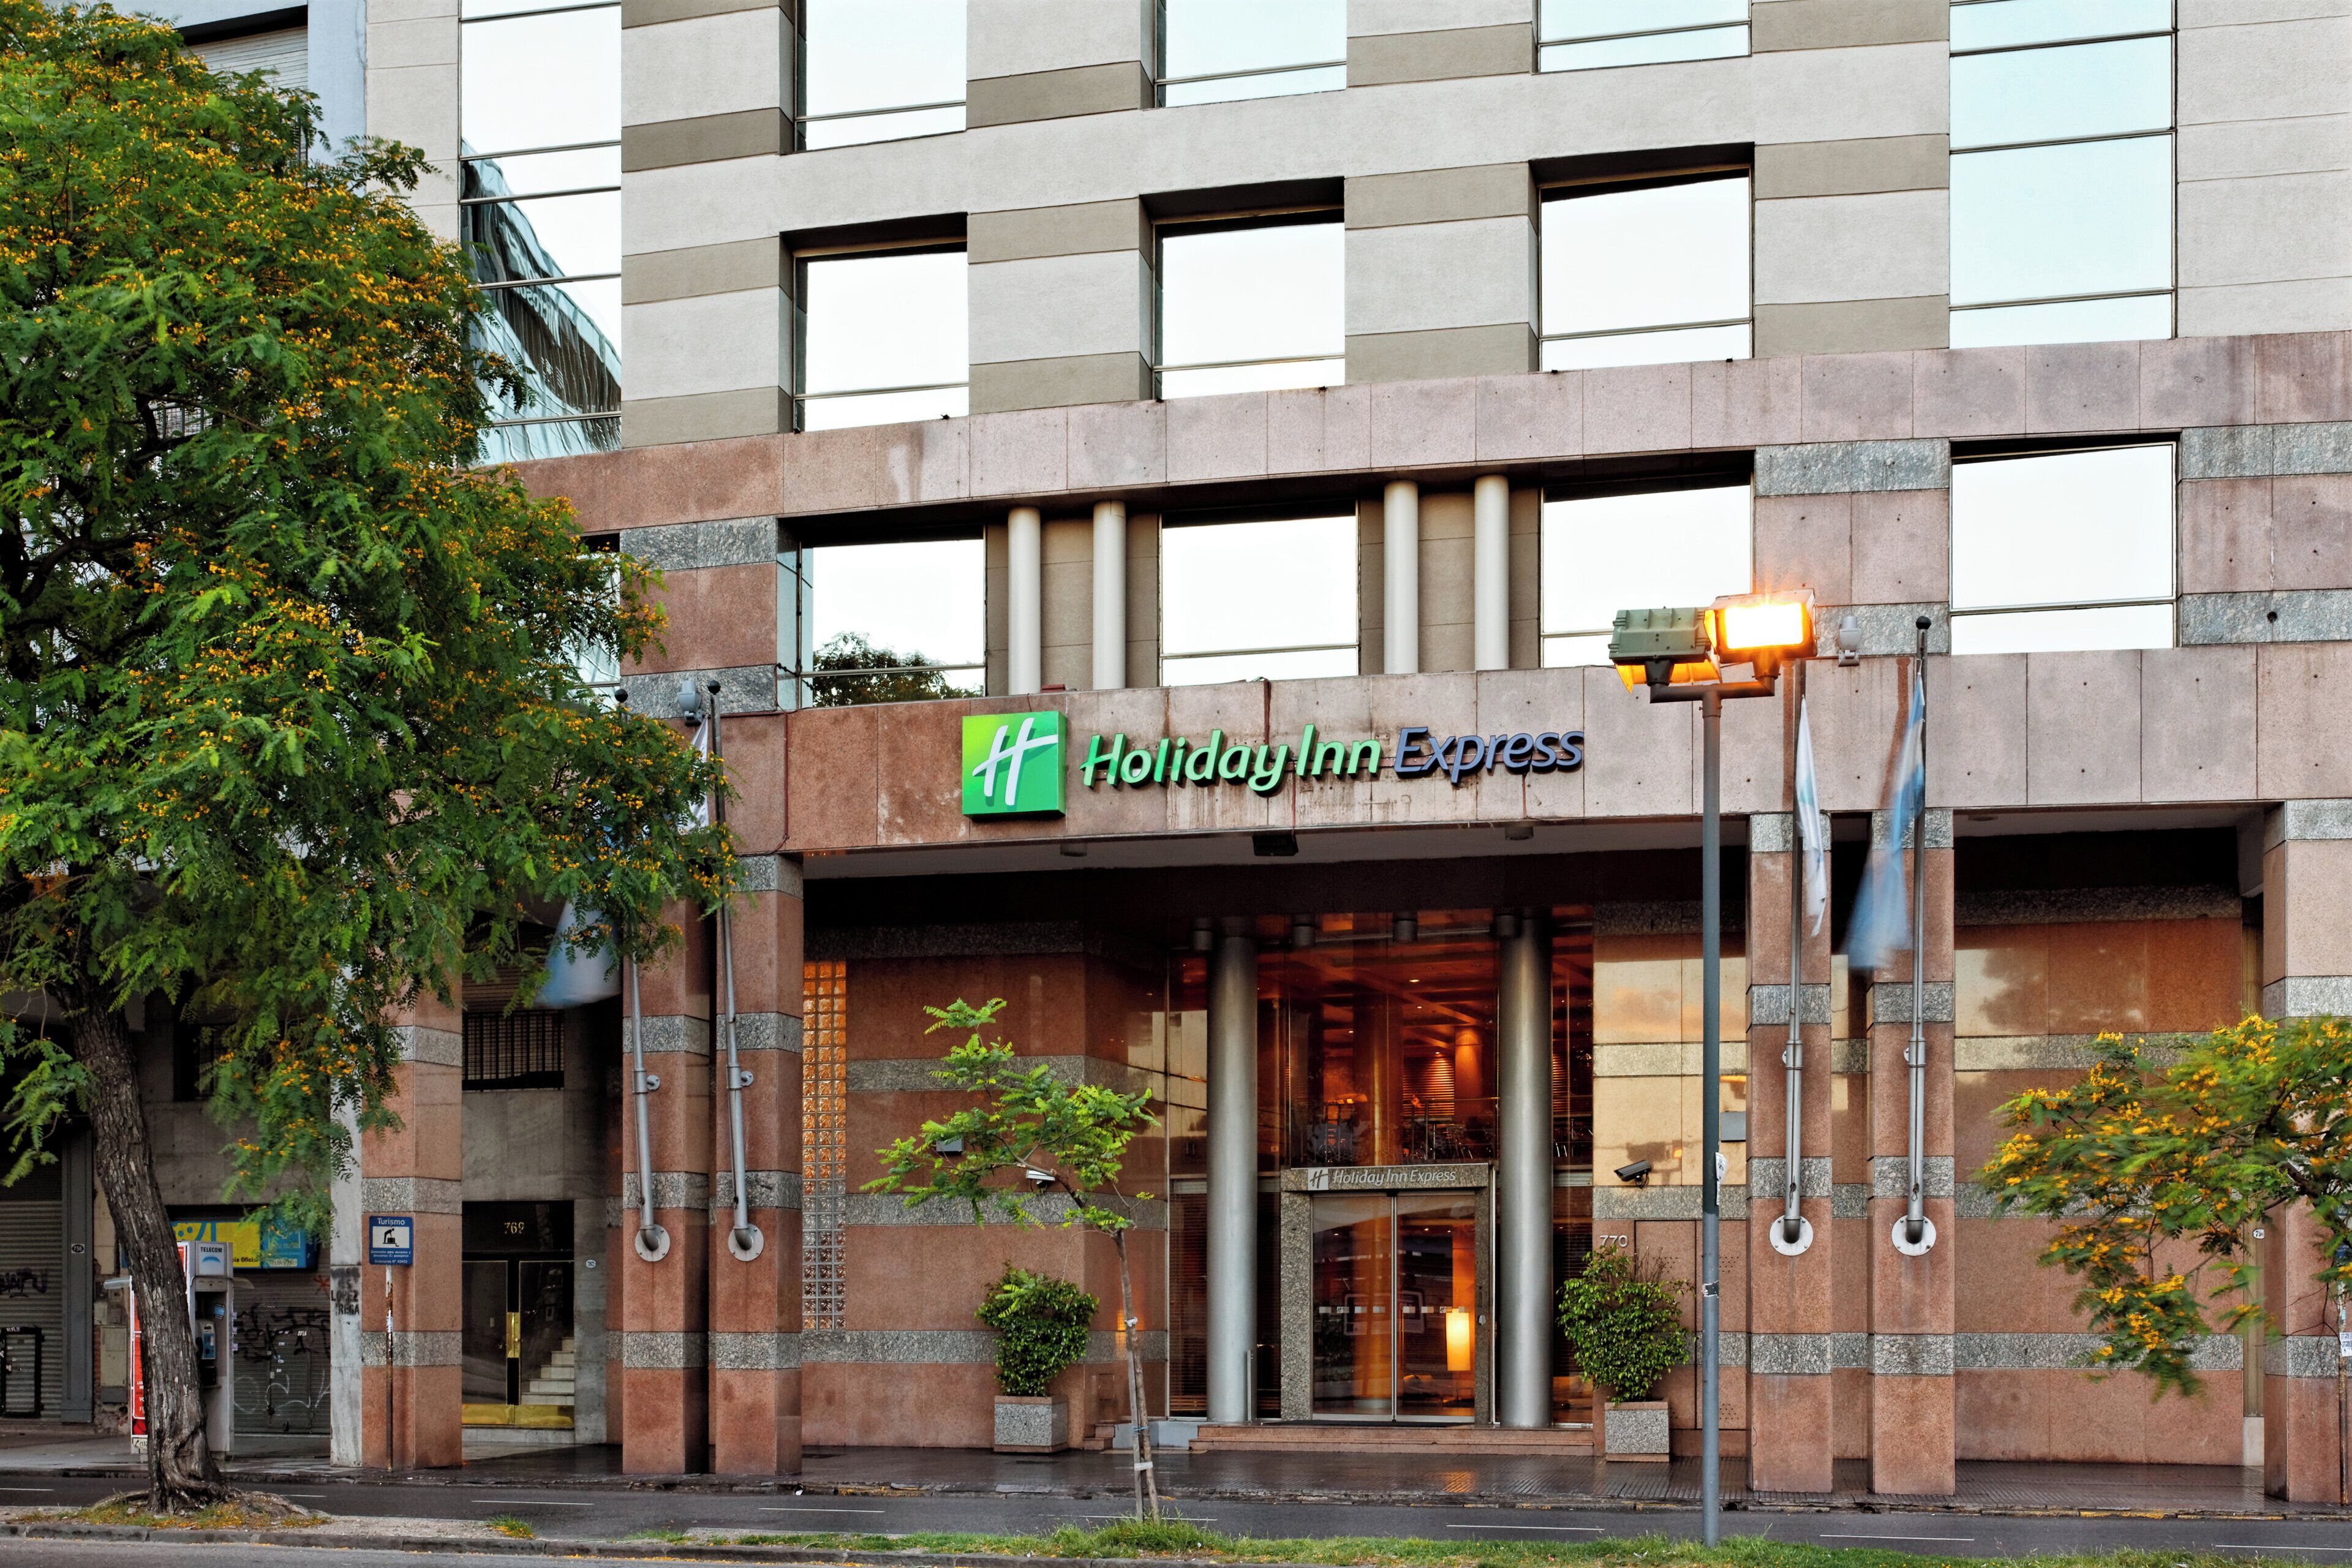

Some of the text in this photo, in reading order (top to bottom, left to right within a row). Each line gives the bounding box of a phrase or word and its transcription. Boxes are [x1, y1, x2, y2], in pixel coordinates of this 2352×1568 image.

[1394, 726, 1585, 785] Express
[1410, 1170, 1456, 1184] Express
[1599, 1235, 1628, 1247] 770
